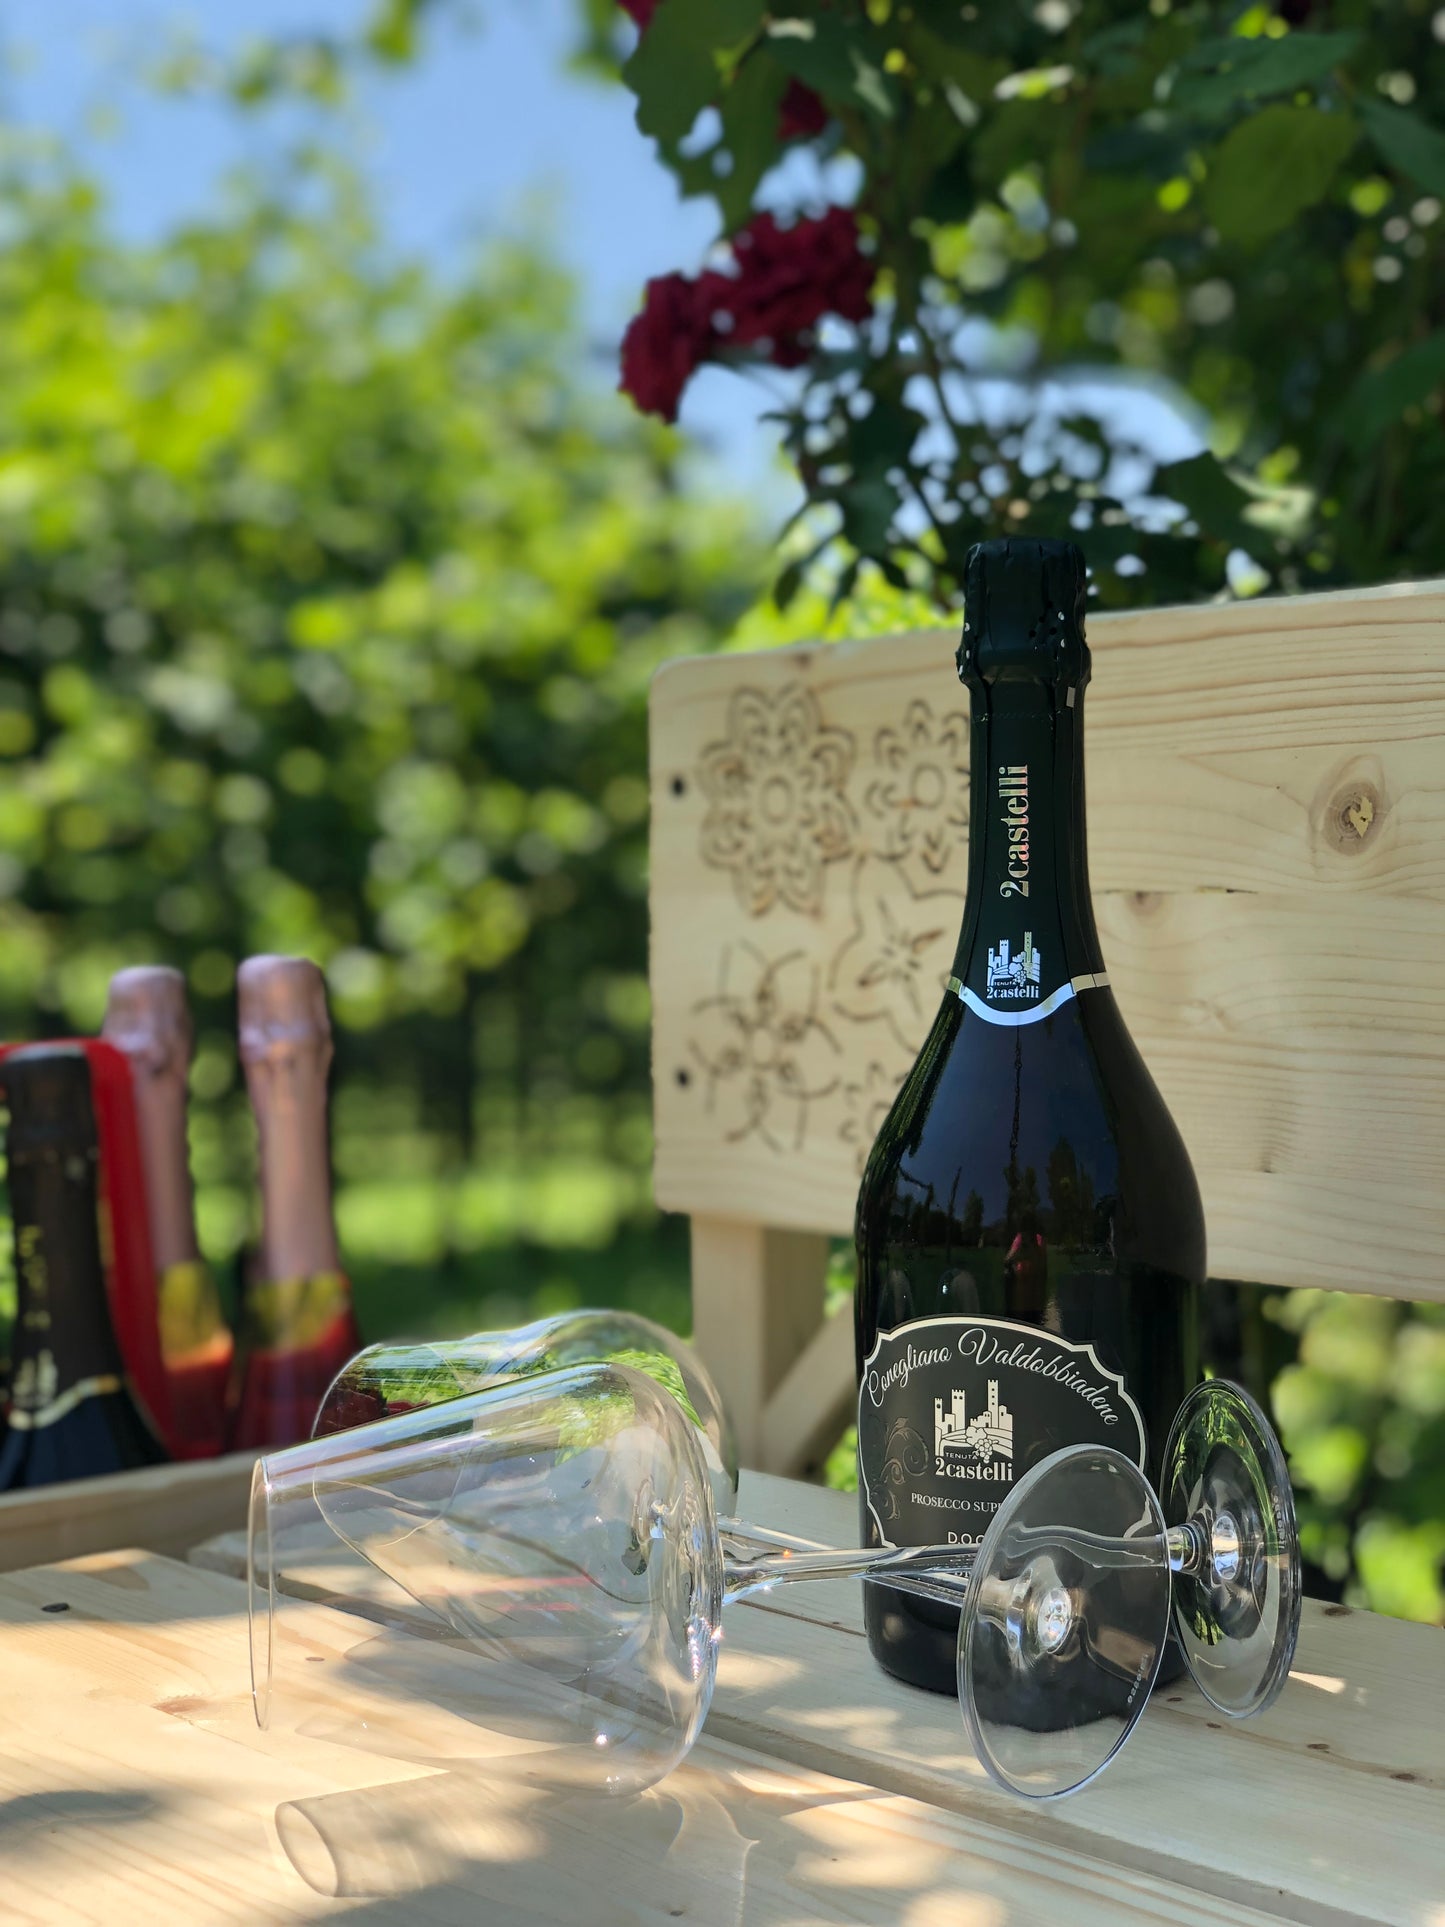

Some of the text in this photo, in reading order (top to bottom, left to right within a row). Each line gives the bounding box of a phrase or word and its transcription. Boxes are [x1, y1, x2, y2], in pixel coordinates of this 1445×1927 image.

[999, 764, 1030, 898] 2castelli
[986, 985, 1040, 999] 2castelli
[866, 1327, 1119, 1426] Conegliano Valdobbiadene
[945, 1452, 979, 1460] TENUTA
[935, 1457, 1013, 1481] 2castelli
[911, 1492, 971, 1511] PROSECCO
